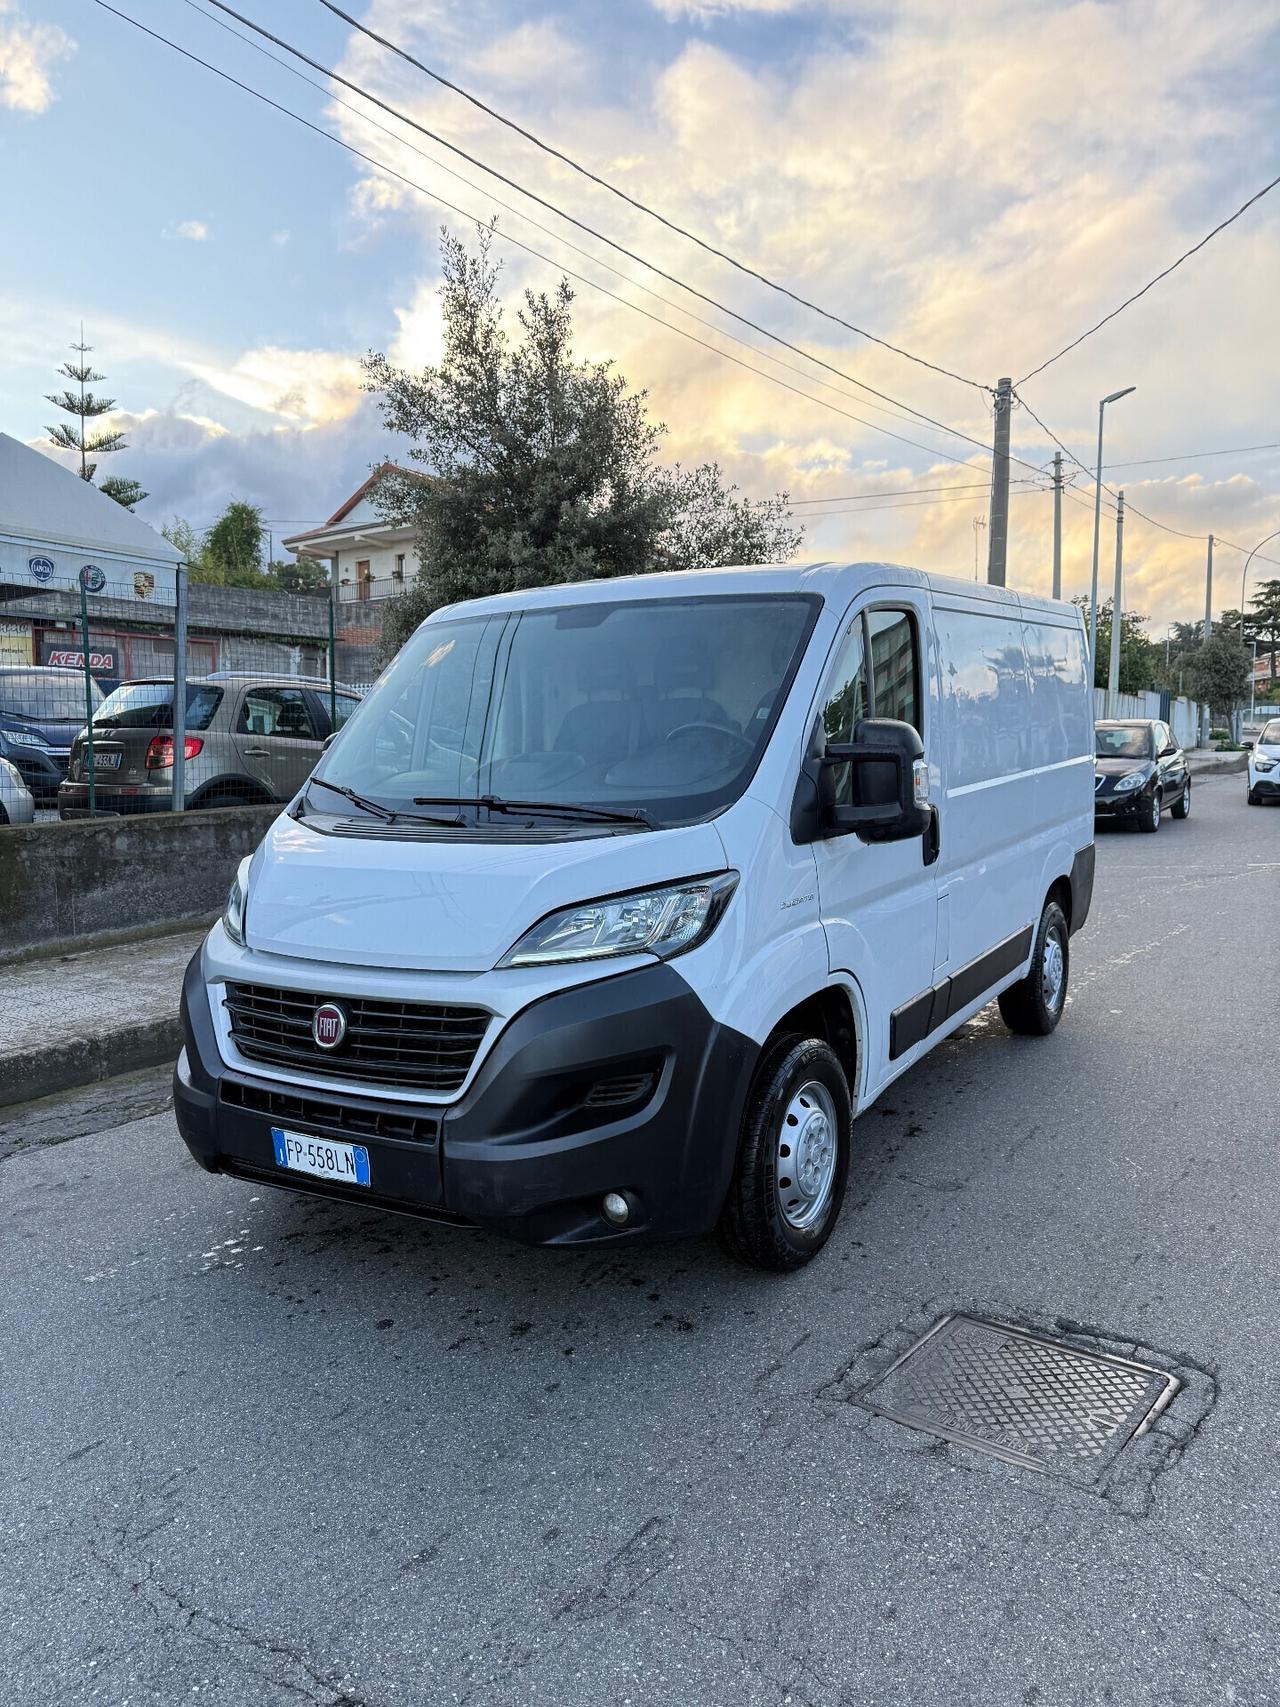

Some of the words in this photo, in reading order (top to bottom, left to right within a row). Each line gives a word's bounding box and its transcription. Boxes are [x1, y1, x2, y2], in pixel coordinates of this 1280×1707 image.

[33, 563, 51, 572] LANCIA
[48, 650, 113, 669] KENDA
[319, 1016, 338, 1037] FIAT
